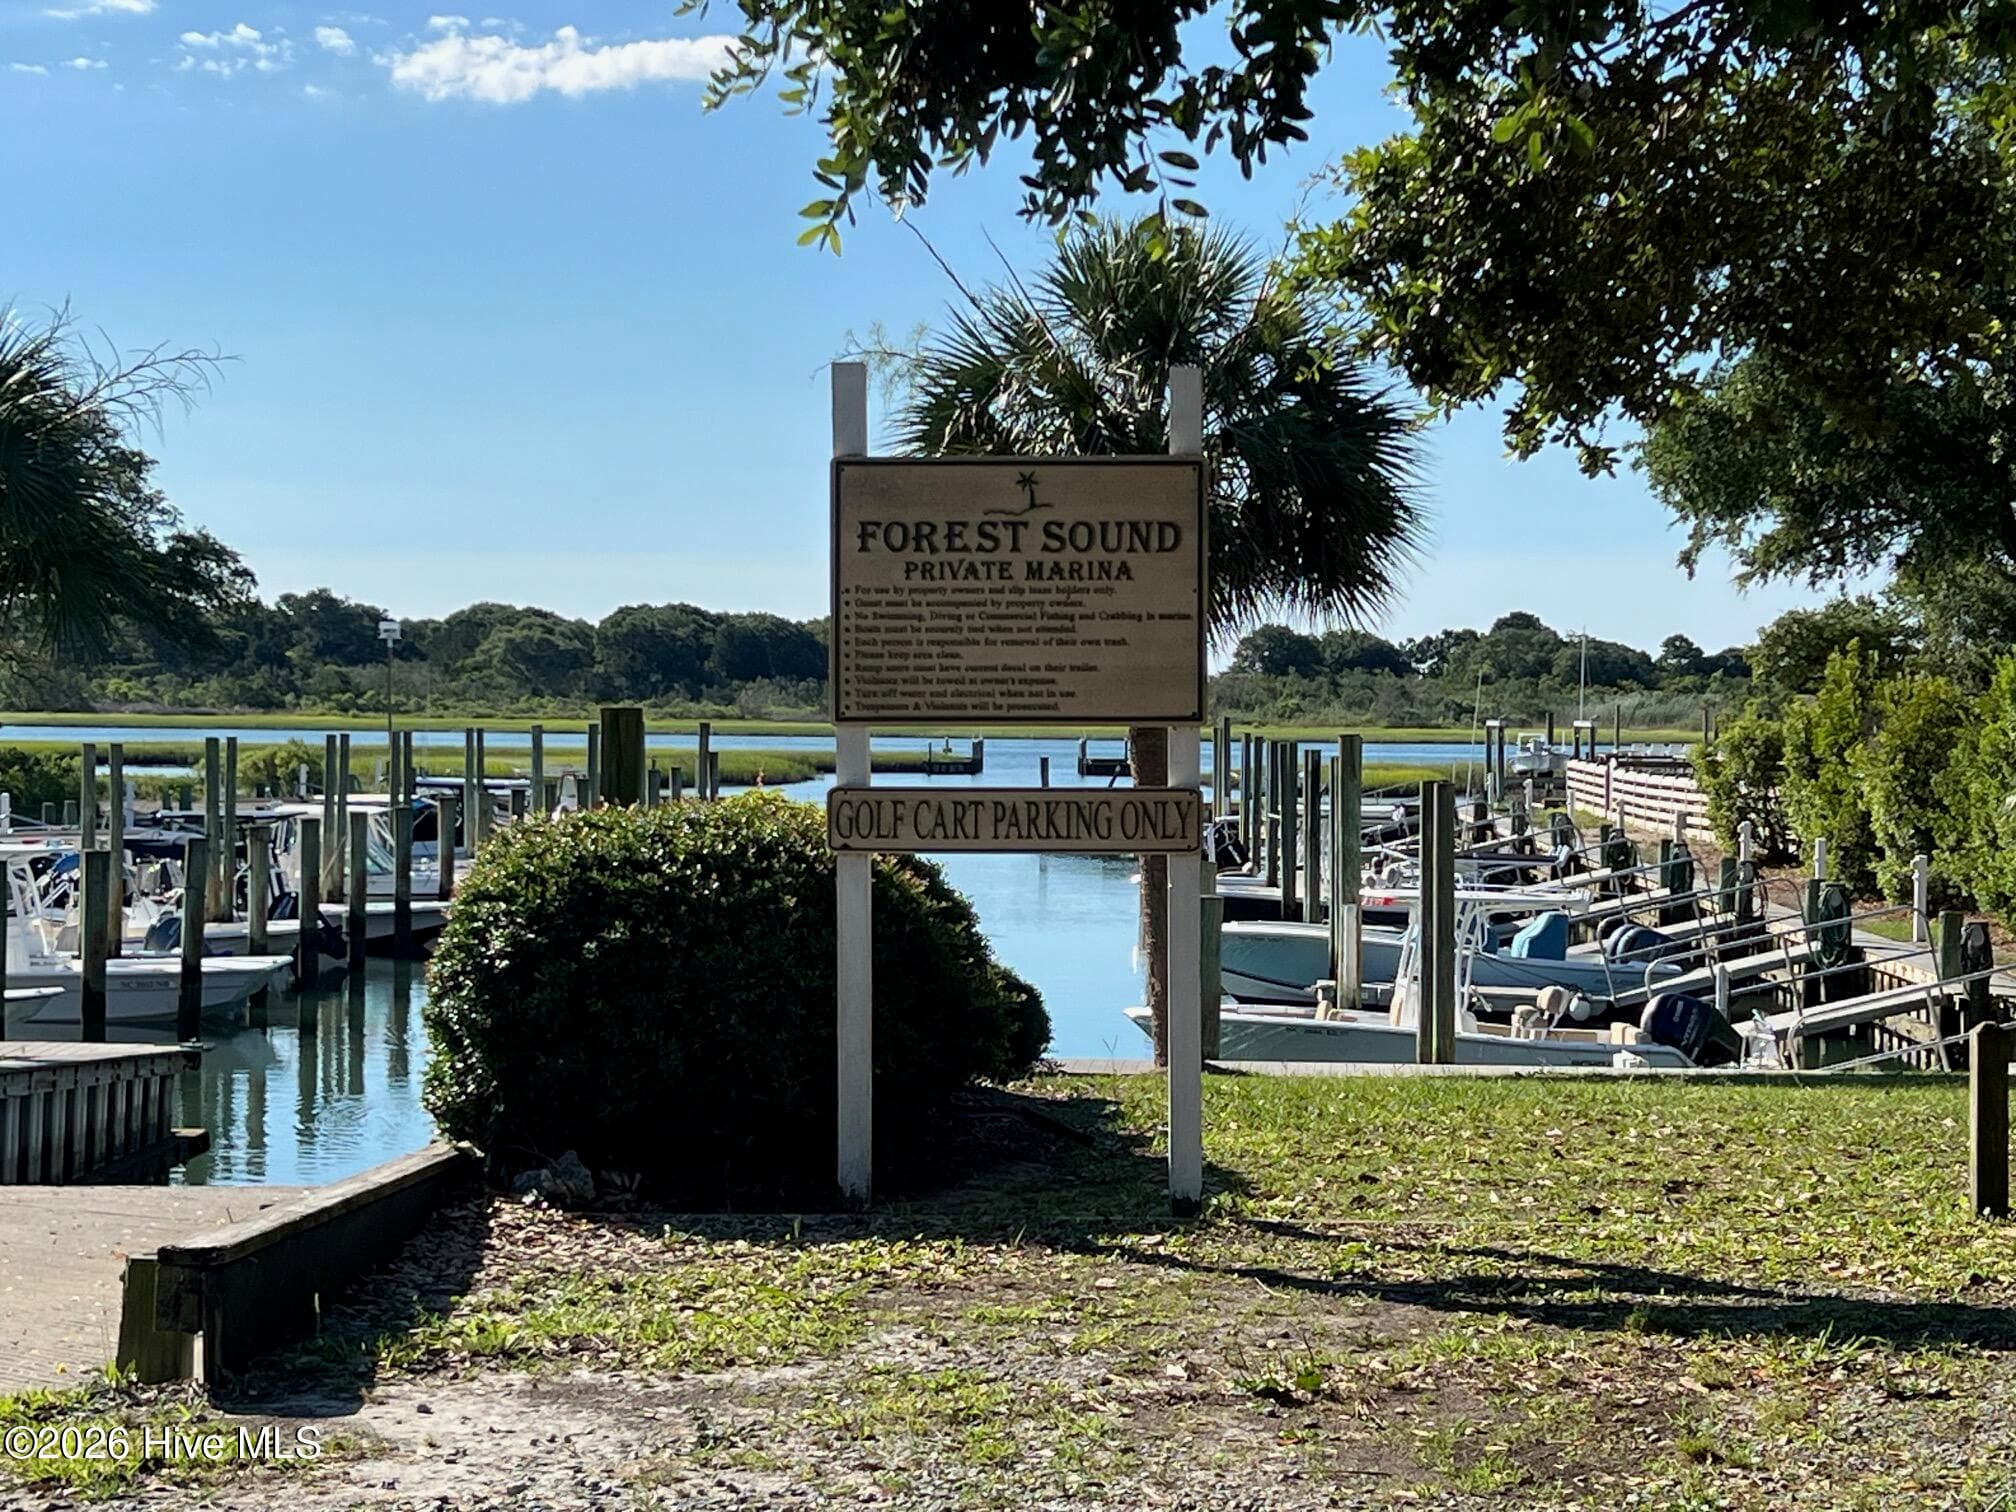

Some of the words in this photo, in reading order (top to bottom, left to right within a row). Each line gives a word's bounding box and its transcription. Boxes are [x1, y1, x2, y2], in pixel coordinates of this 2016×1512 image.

[857, 521, 1029, 553] FOREST
[1041, 521, 1182, 553] SOUND
[904, 559, 1013, 581] PRIVATE
[1025, 560, 1134, 581] MARINA
[854, 584, 871, 594] For
[893, 584, 903, 596] by
[908, 584, 947, 596] property
[989, 584, 1005, 594] and
[1008, 584, 1025, 596] slip
[1056, 584, 1090, 594] holders
[885, 598, 908, 607] must
[911, 598, 922, 607] be
[926, 598, 987, 609] accompanied
[991, 598, 1001, 609] by
[1006, 598, 1045, 609] property
[855, 610, 868, 620] No
[930, 610, 962, 622] Diving
[979, 610, 1036, 620] Commercial
[1040, 610, 1075, 622] Fishing
[1079, 610, 1095, 620] and
[1099, 610, 1143, 622] Crabbing
[1147, 610, 1155, 620] in
[885, 624, 907, 633] must
[911, 624, 921, 633] be
[925, 624, 963, 635] securely
[967, 624, 985, 633] tied
[988, 624, 1013, 633] when
[1017, 624, 1032, 633] not
[855, 636, 878, 646] Each
[881, 639, 912, 648] person
[916, 636, 923, 646] is
[926, 636, 980, 648] responsible
[985, 636, 997, 646] for
[1001, 636, 1039, 646] removal
[1043, 636, 1052, 646] of
[1056, 636, 1076, 646] their
[855, 649, 884, 659] Please
[888, 649, 910, 661] keep
[855, 662, 882, 674] Ramp
[913, 662, 936, 672] must
[939, 662, 961, 672] have
[965, 662, 998, 672] current
[1001, 662, 1026, 672] decal
[1045, 662, 1066, 672] their
[901, 675, 919, 685] will
[922, 675, 933, 685] be
[936, 675, 965, 685] towed
[969, 675, 977, 685] at
[855, 688, 877, 698] Turn
[881, 688, 898, 698] off
[900, 688, 926, 698] water
[929, 688, 947, 698] and
[950, 688, 995, 698] electrical
[999, 688, 1024, 698] when
[1028, 688, 1043, 698] not
[1047, 688, 1056, 698] in
[913, 701, 921, 711] &
[971, 701, 989, 711] will
[993, 701, 1003, 711] be
[835, 800, 906, 840] GOLF
[913, 800, 985, 840] CART
[993, 800, 1112, 840] PARKING
[1120, 800, 1194, 840] ONLY
